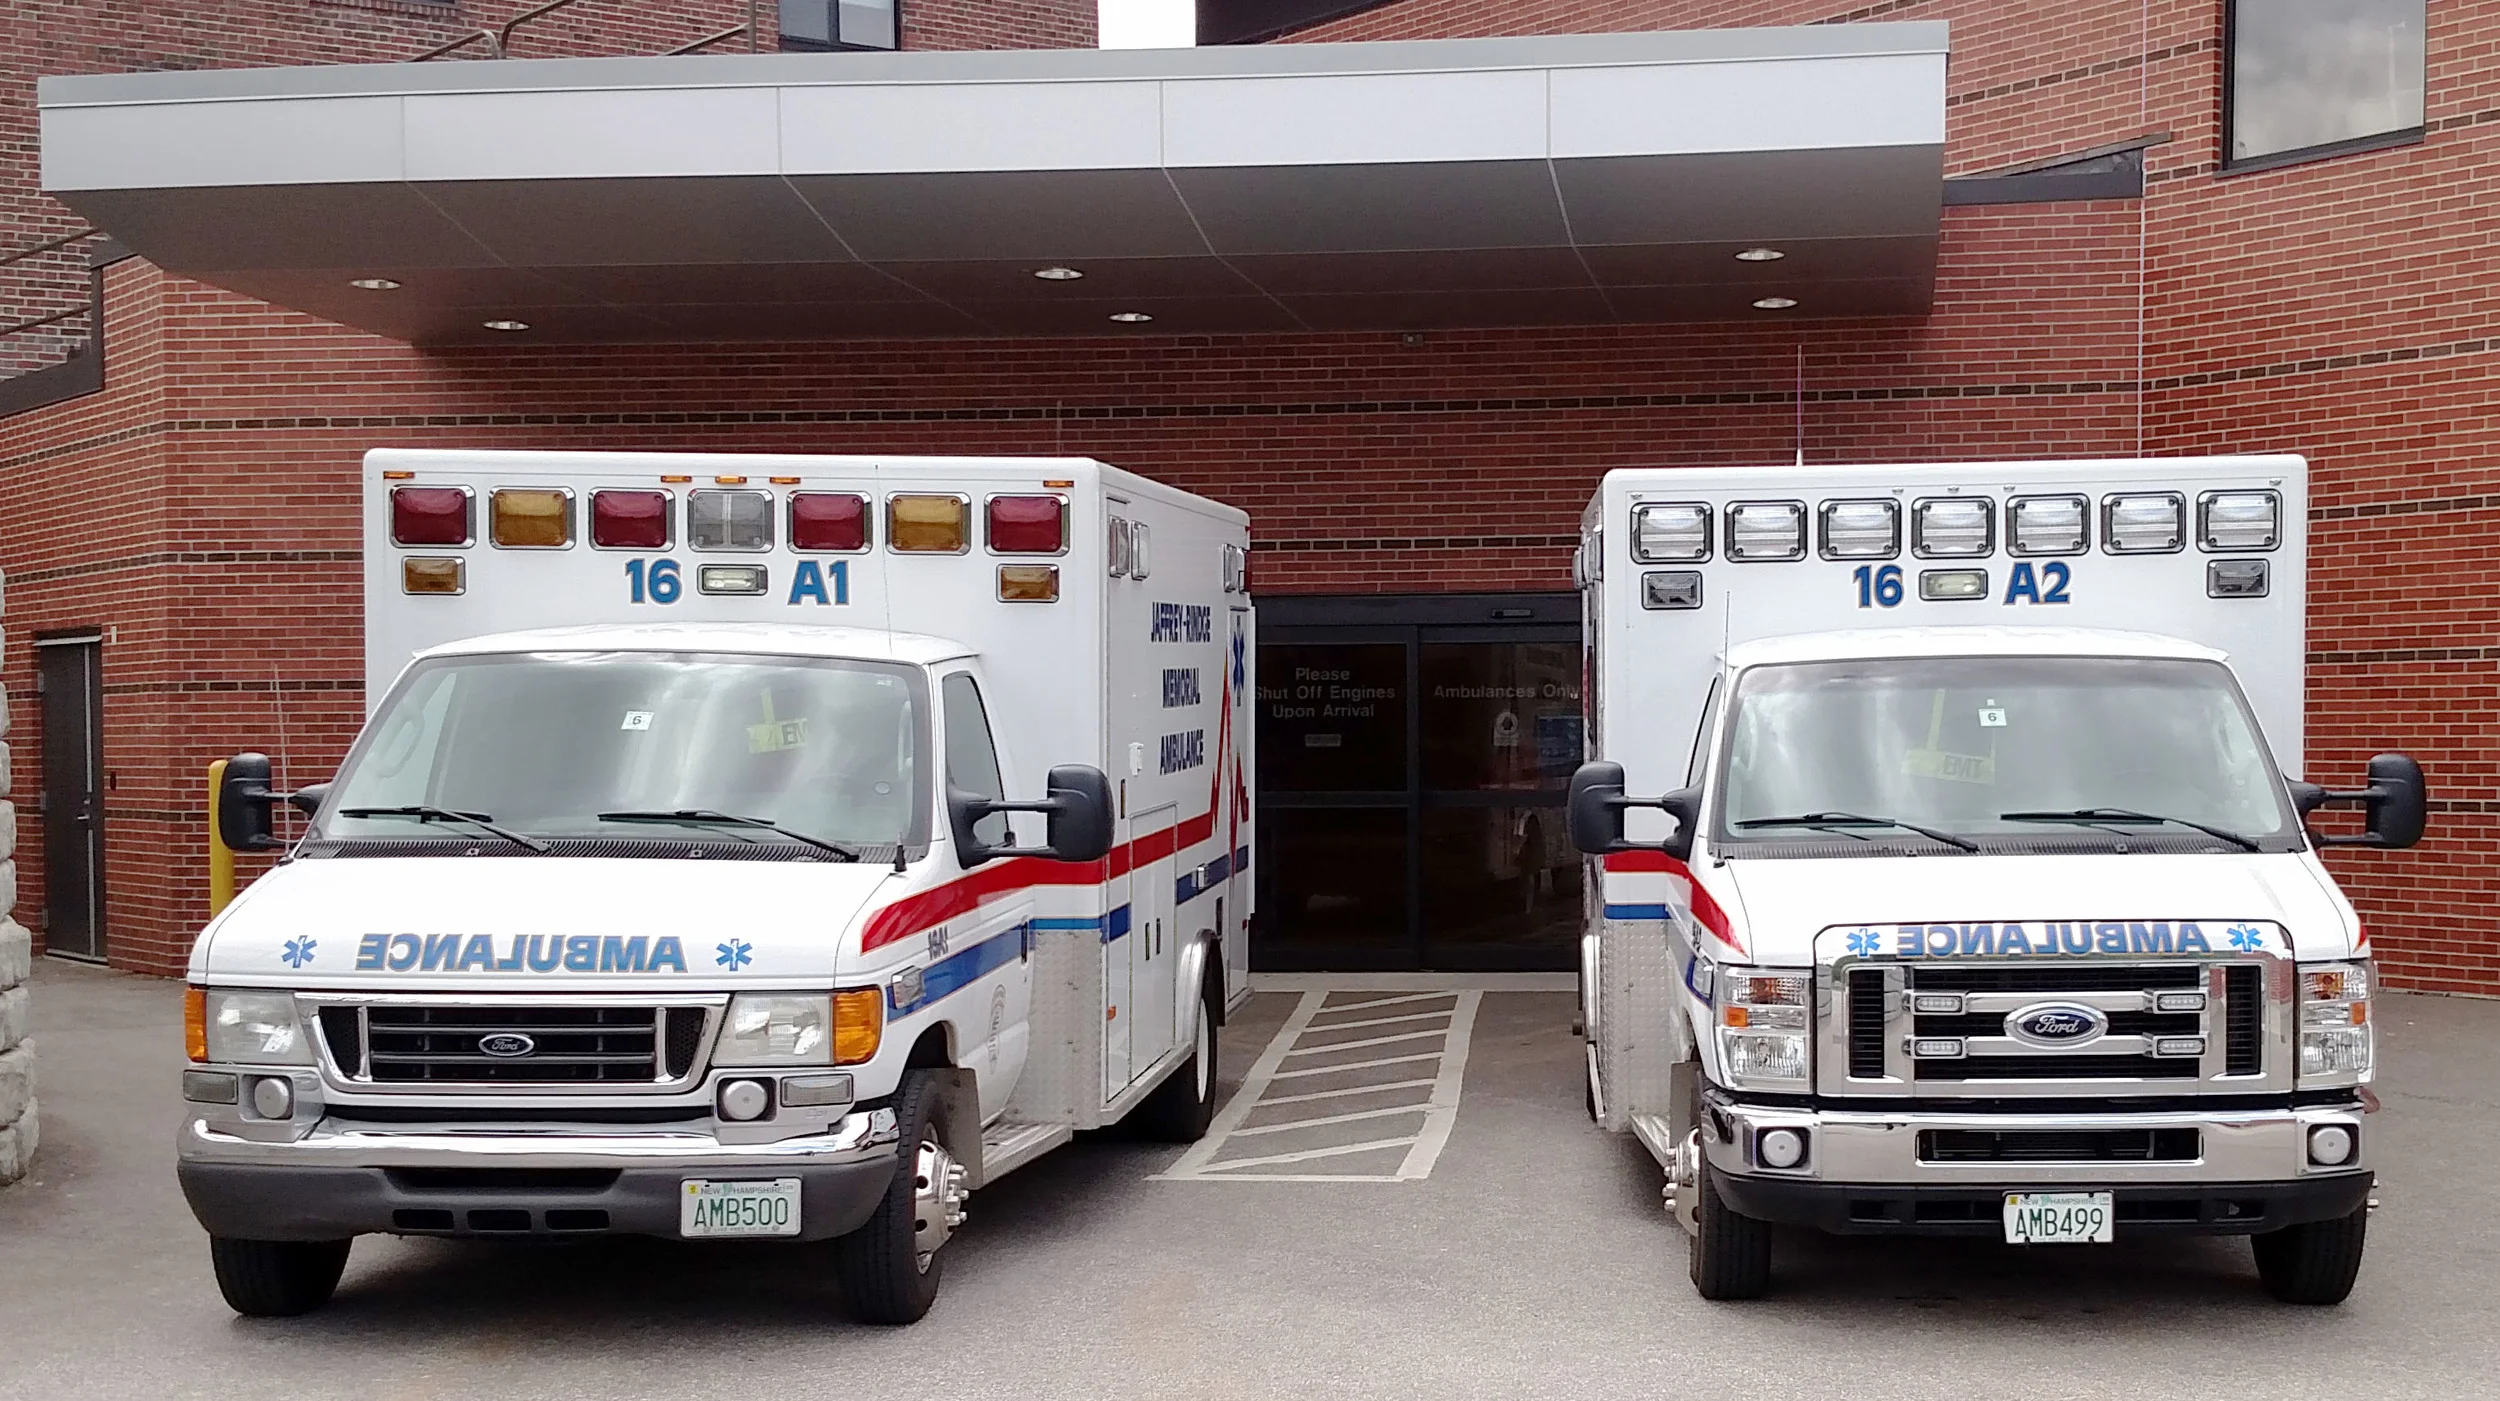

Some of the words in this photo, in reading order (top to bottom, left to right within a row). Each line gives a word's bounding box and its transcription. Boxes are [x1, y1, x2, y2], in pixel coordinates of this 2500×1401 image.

[625, 558, 683, 605] 16
[787, 559, 850, 606] A1
[1852, 563, 1905, 609] 16
[2002, 560, 2071, 606] A2
[1295, 667, 1350, 681] Please
[1162, 667, 1201, 709] MEMORIAL
[1256, 685, 1289, 700] Shut
[1296, 685, 1323, 700] Off
[1330, 685, 1396, 702] Engines
[1434, 685, 1537, 699] Ambulances
[1272, 704, 1315, 720] Upon
[1323, 703, 1376, 718] Arrival
[1987, 712, 1998, 722] 6
[632, 715, 642, 726] 6
[1159, 729, 1204, 776] AMBULANCE
[2034, 1014, 2080, 1034] Ford
[491, 1038, 520, 1050] Ford
[701, 1187, 720, 1195] NEW
[733, 1186, 783, 1194] HAMPSHIRE
[2020, 1198, 2039, 1206] NEW
[2050, 1197, 2097, 1205] HAMPSHIRE
[694, 1197, 789, 1227] AMB500
[2015, 1207, 2103, 1237] AMB499
